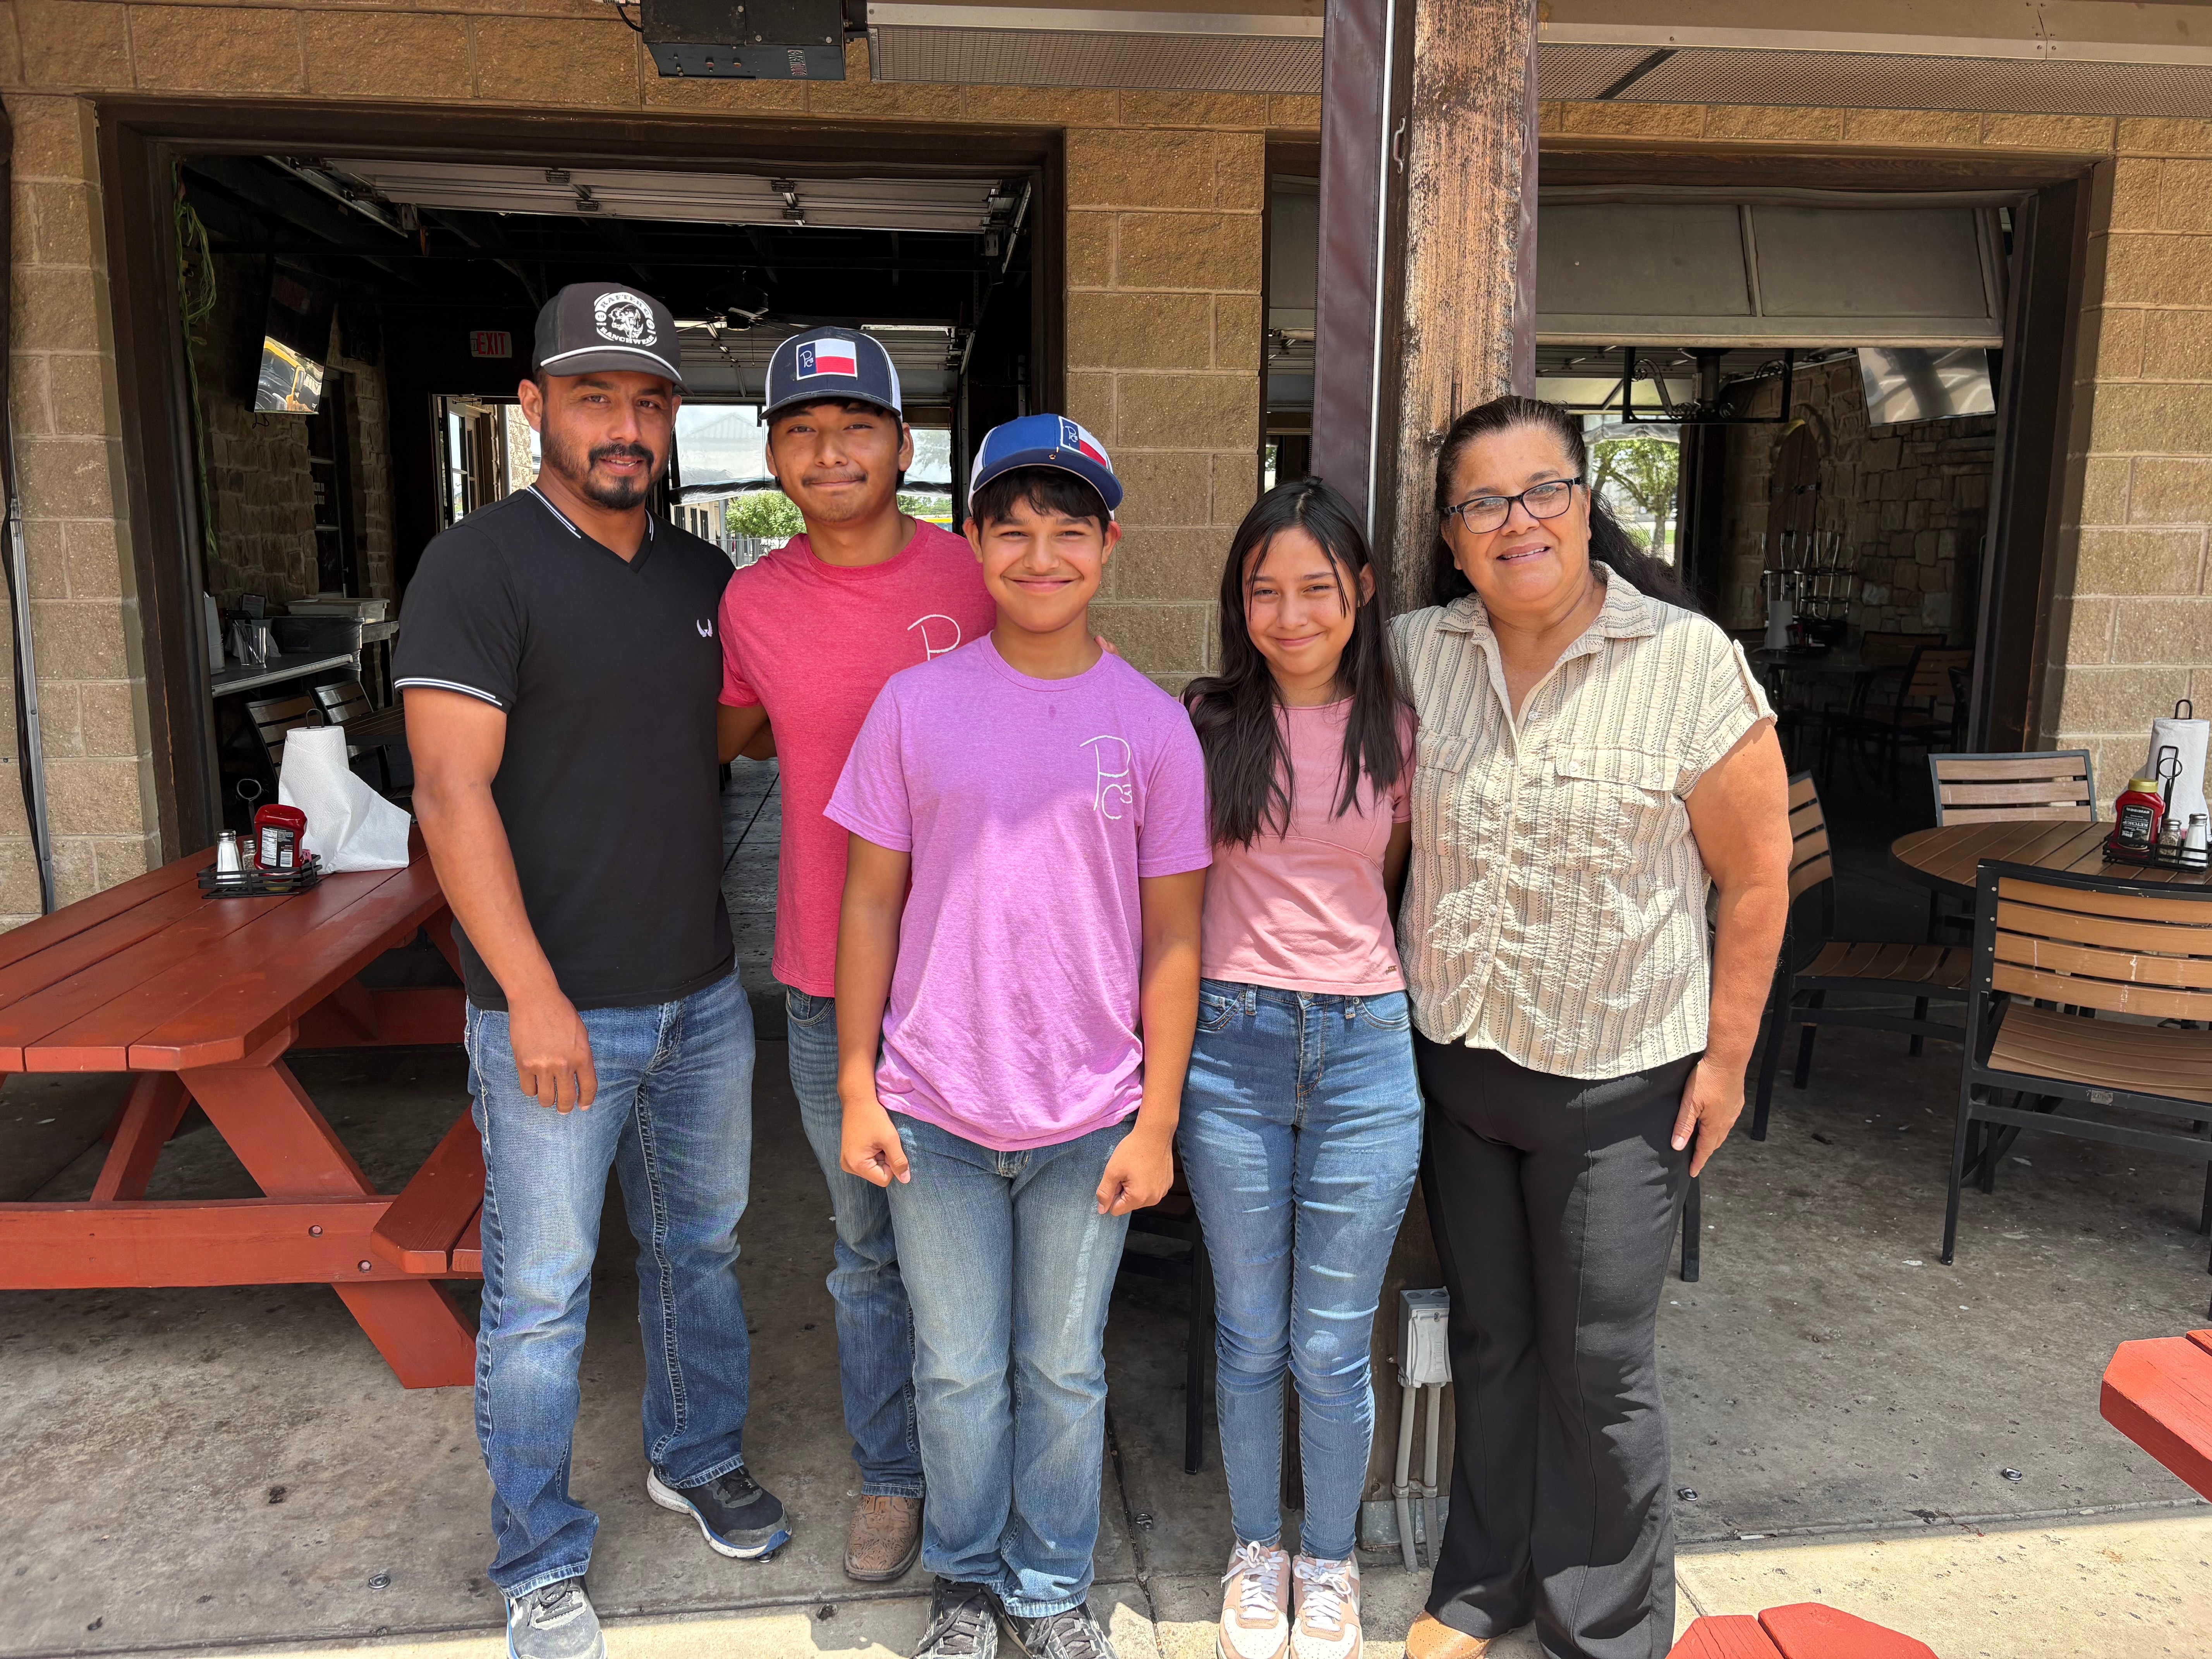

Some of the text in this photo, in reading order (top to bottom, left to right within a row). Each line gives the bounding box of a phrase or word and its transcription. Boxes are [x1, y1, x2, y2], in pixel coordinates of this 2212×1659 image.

[600, 294, 642, 309] RAFTER
[477, 332, 506, 355] EXIT
[600, 327, 654, 345] RANCHWEAR
